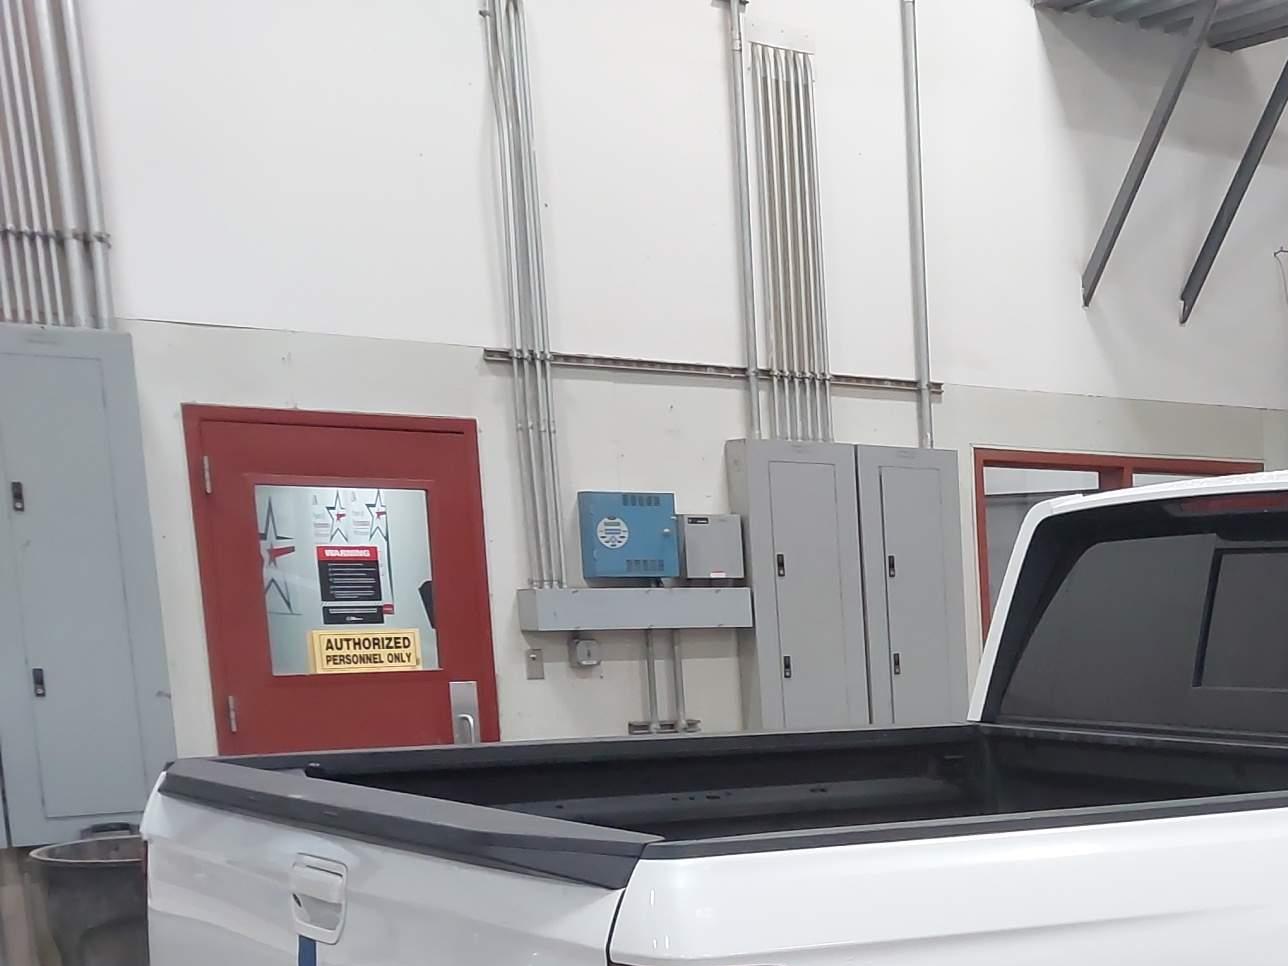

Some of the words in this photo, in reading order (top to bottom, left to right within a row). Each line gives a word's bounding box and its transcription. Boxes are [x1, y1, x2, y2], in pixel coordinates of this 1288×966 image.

[325, 637, 411, 651] AUTHORIZED
[326, 653, 384, 665] PERSONNEL
[387, 652, 412, 663] ONLY
